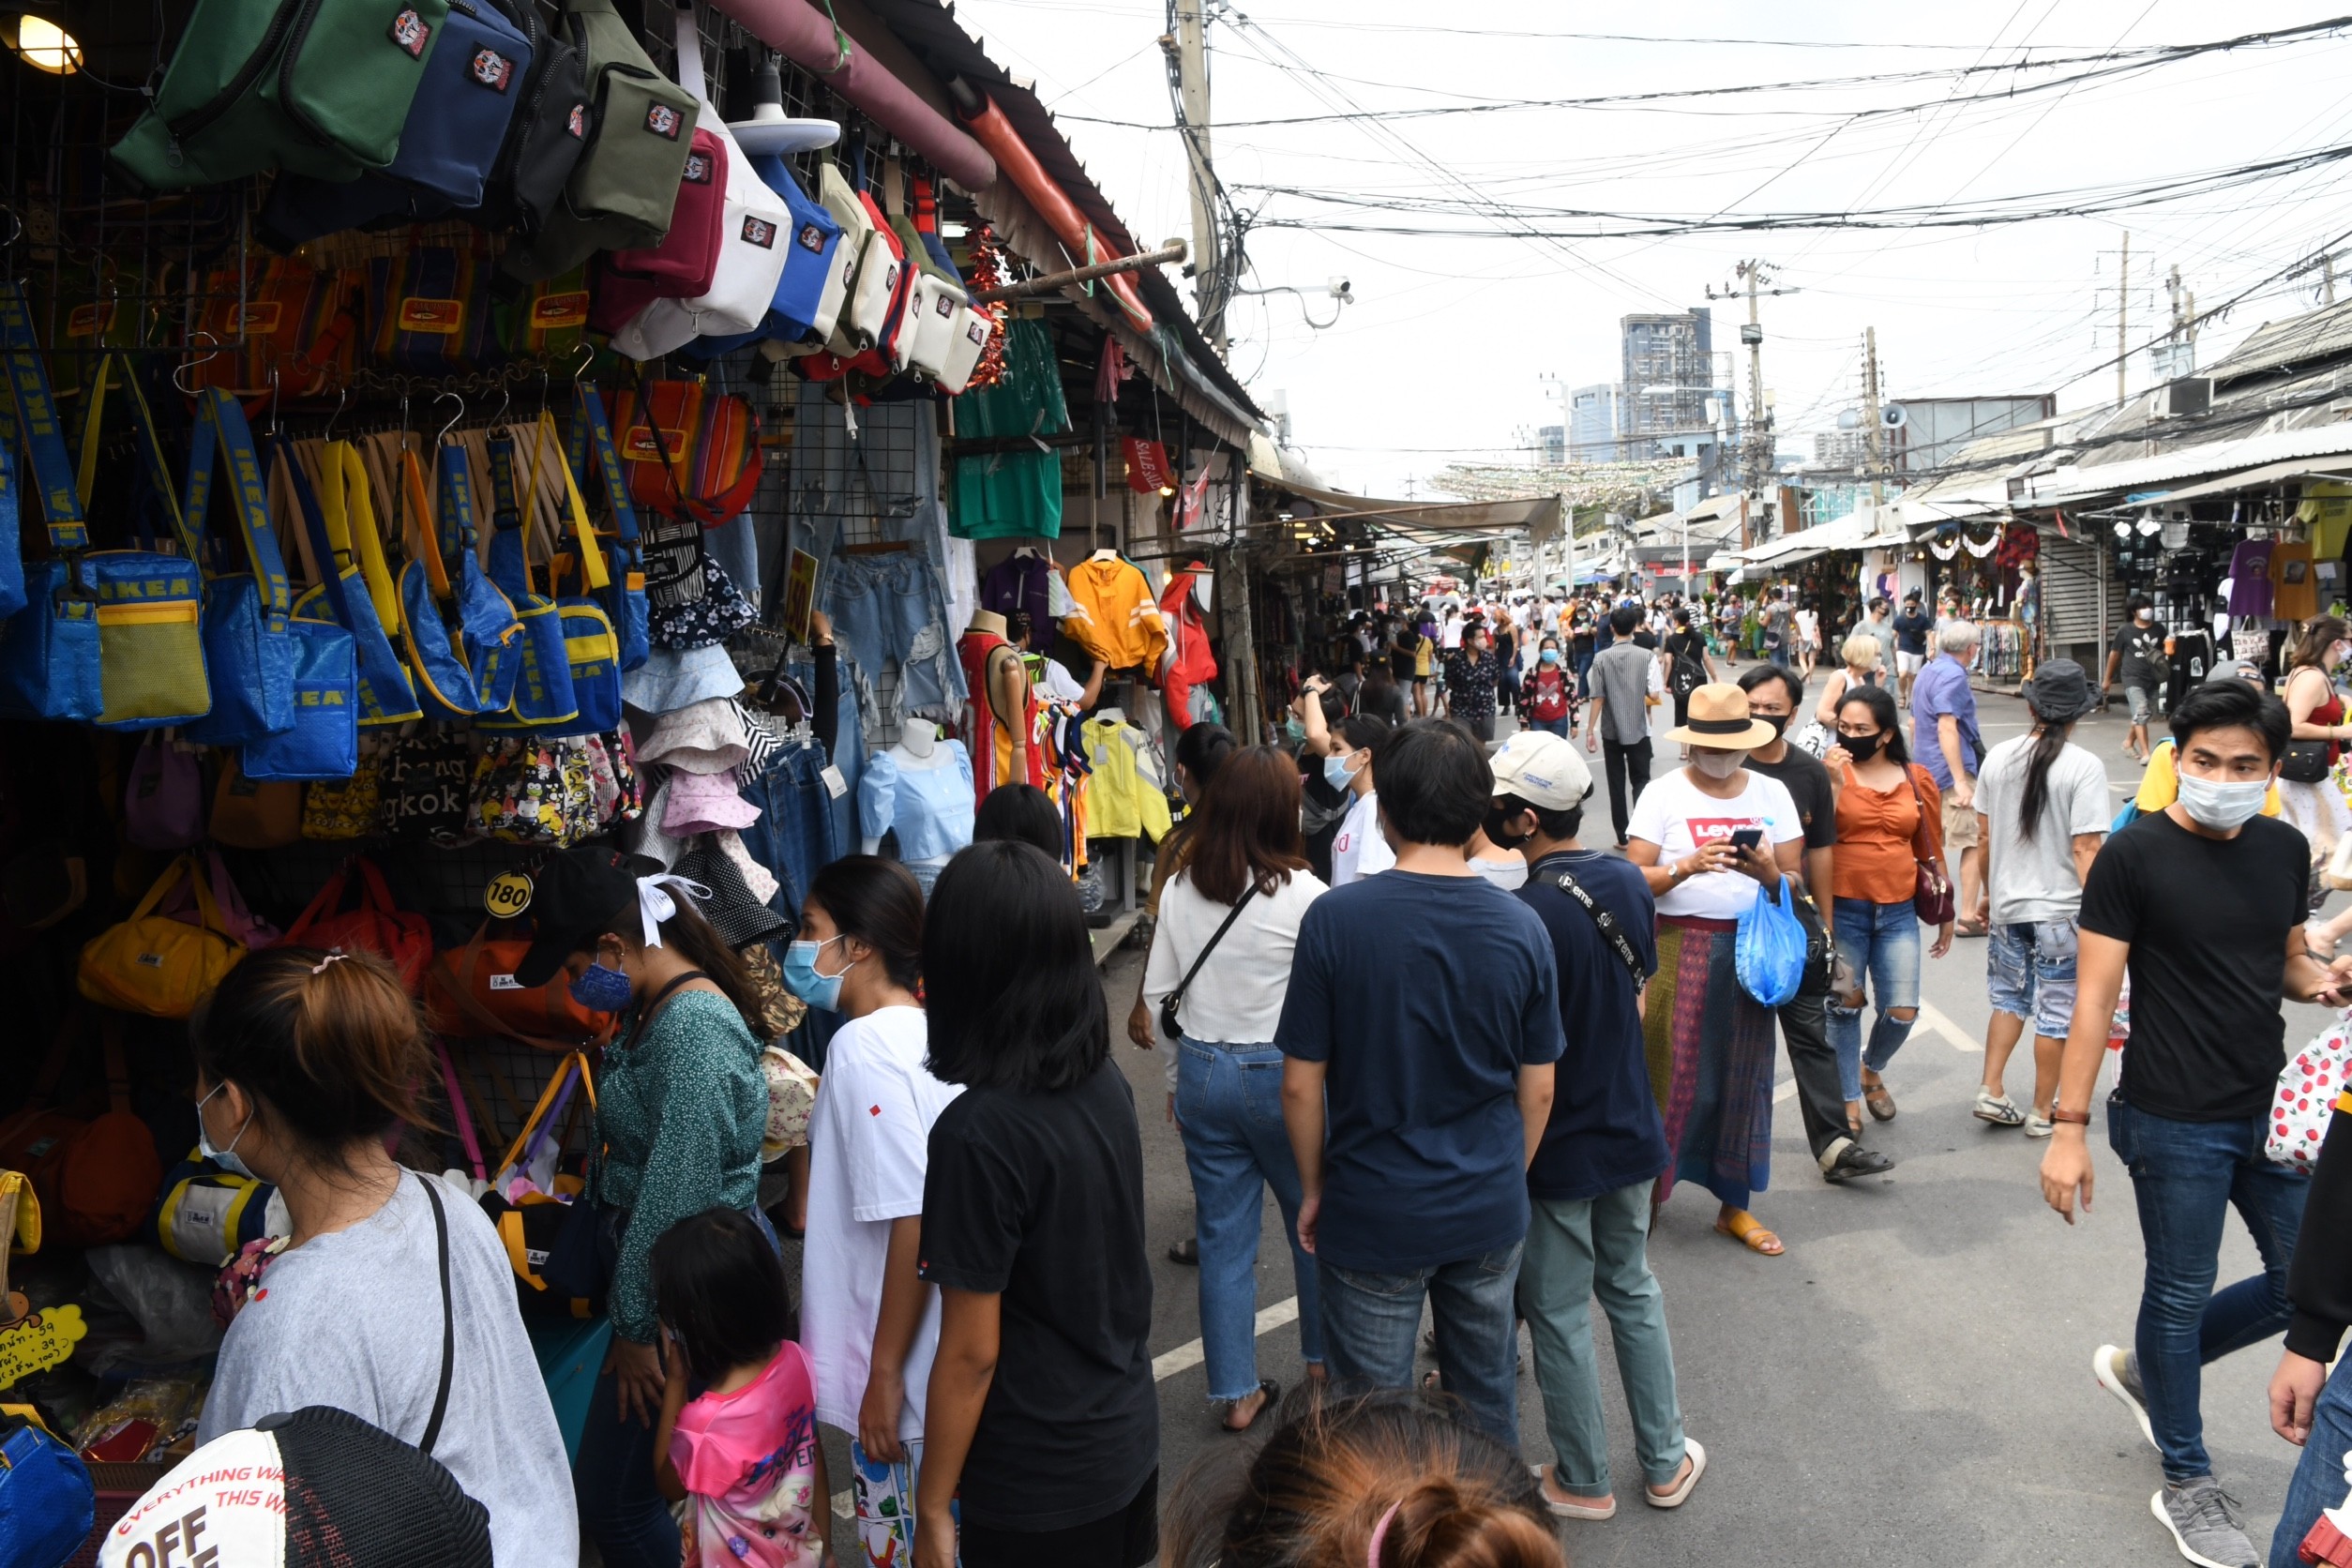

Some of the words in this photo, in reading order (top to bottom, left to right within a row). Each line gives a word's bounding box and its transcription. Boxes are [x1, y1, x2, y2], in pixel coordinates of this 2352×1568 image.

[13, 342, 53, 435] IKEA
[1135, 440, 1155, 471] SALE
[235, 449, 265, 529] IKEA
[1142, 469, 1167, 490] SALE
[186, 471, 207, 551] IKEA
[98, 578, 190, 600] IKEA
[522, 639, 545, 702] IKEA
[571, 665, 603, 680] EA
[294, 690, 344, 706] EA
[490, 882, 527, 907] 180
[38, 1322, 54, 1336] 59
[41, 1338, 54, 1350] 39
[117, 1467, 252, 1536] EVERYTHING
[215, 1489, 264, 1508] THIS
[126, 1504, 207, 1568] OFF
